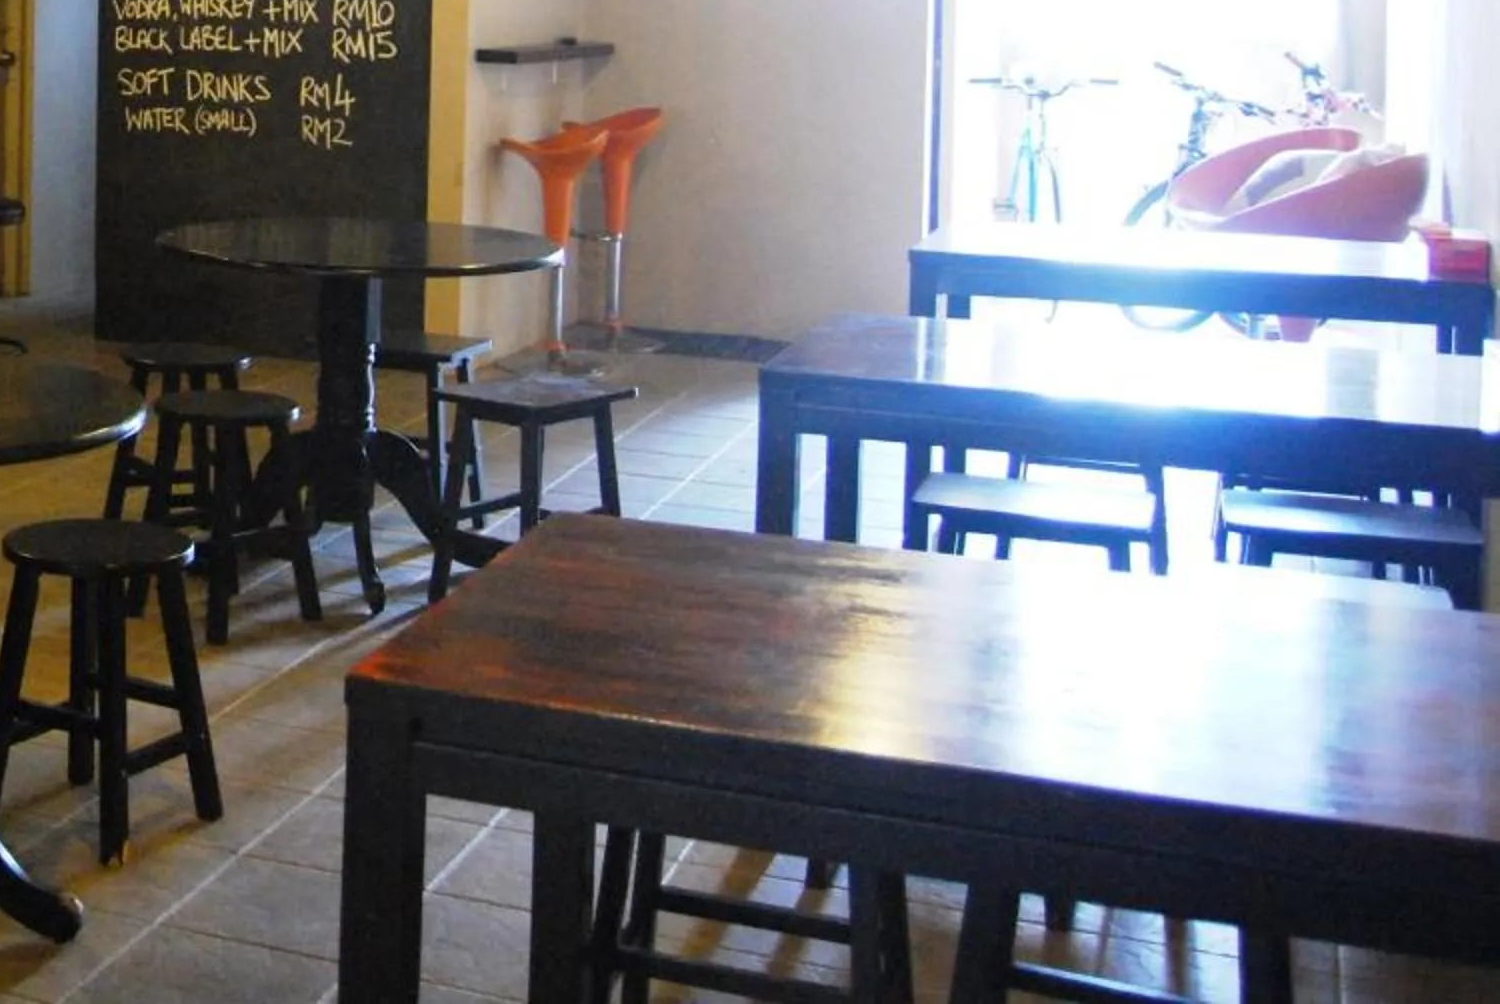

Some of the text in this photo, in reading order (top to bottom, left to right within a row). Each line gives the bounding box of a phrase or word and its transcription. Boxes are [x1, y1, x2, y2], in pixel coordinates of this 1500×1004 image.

[115, 25, 172, 55] BLACK
[180, 27, 241, 51] LABEL
[332, 27, 399, 64] RM15
[117, 67, 175, 97] SOFT
[186, 69, 272, 102] DRINKS
[125, 107, 353, 150] WATER (SMALL) RM2
